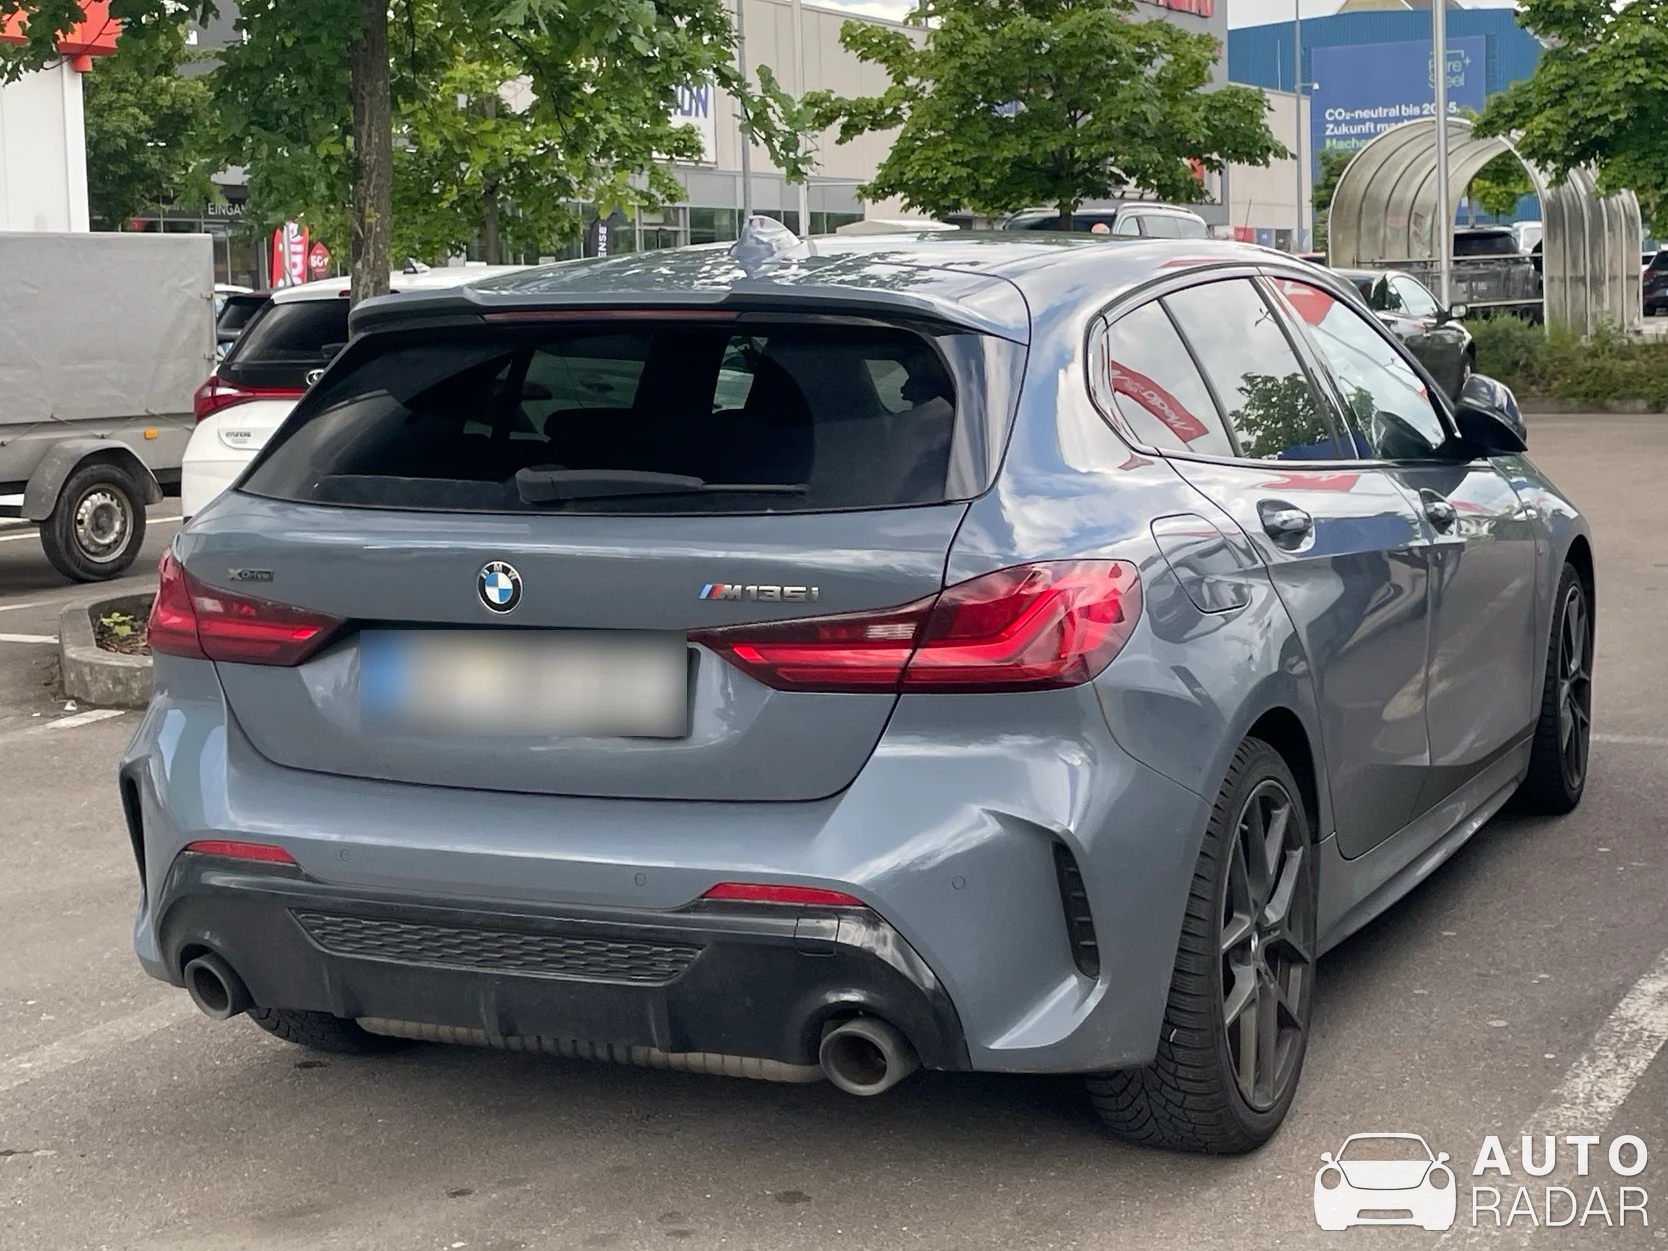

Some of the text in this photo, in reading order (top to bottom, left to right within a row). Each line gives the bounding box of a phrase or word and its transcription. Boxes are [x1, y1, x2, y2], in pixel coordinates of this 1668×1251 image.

[1401, 103, 1421, 116] bis
[1422, 101, 1460, 115] 205.
[1325, 121, 1375, 136] Zukunft
[480, 562, 519, 581] BMW
